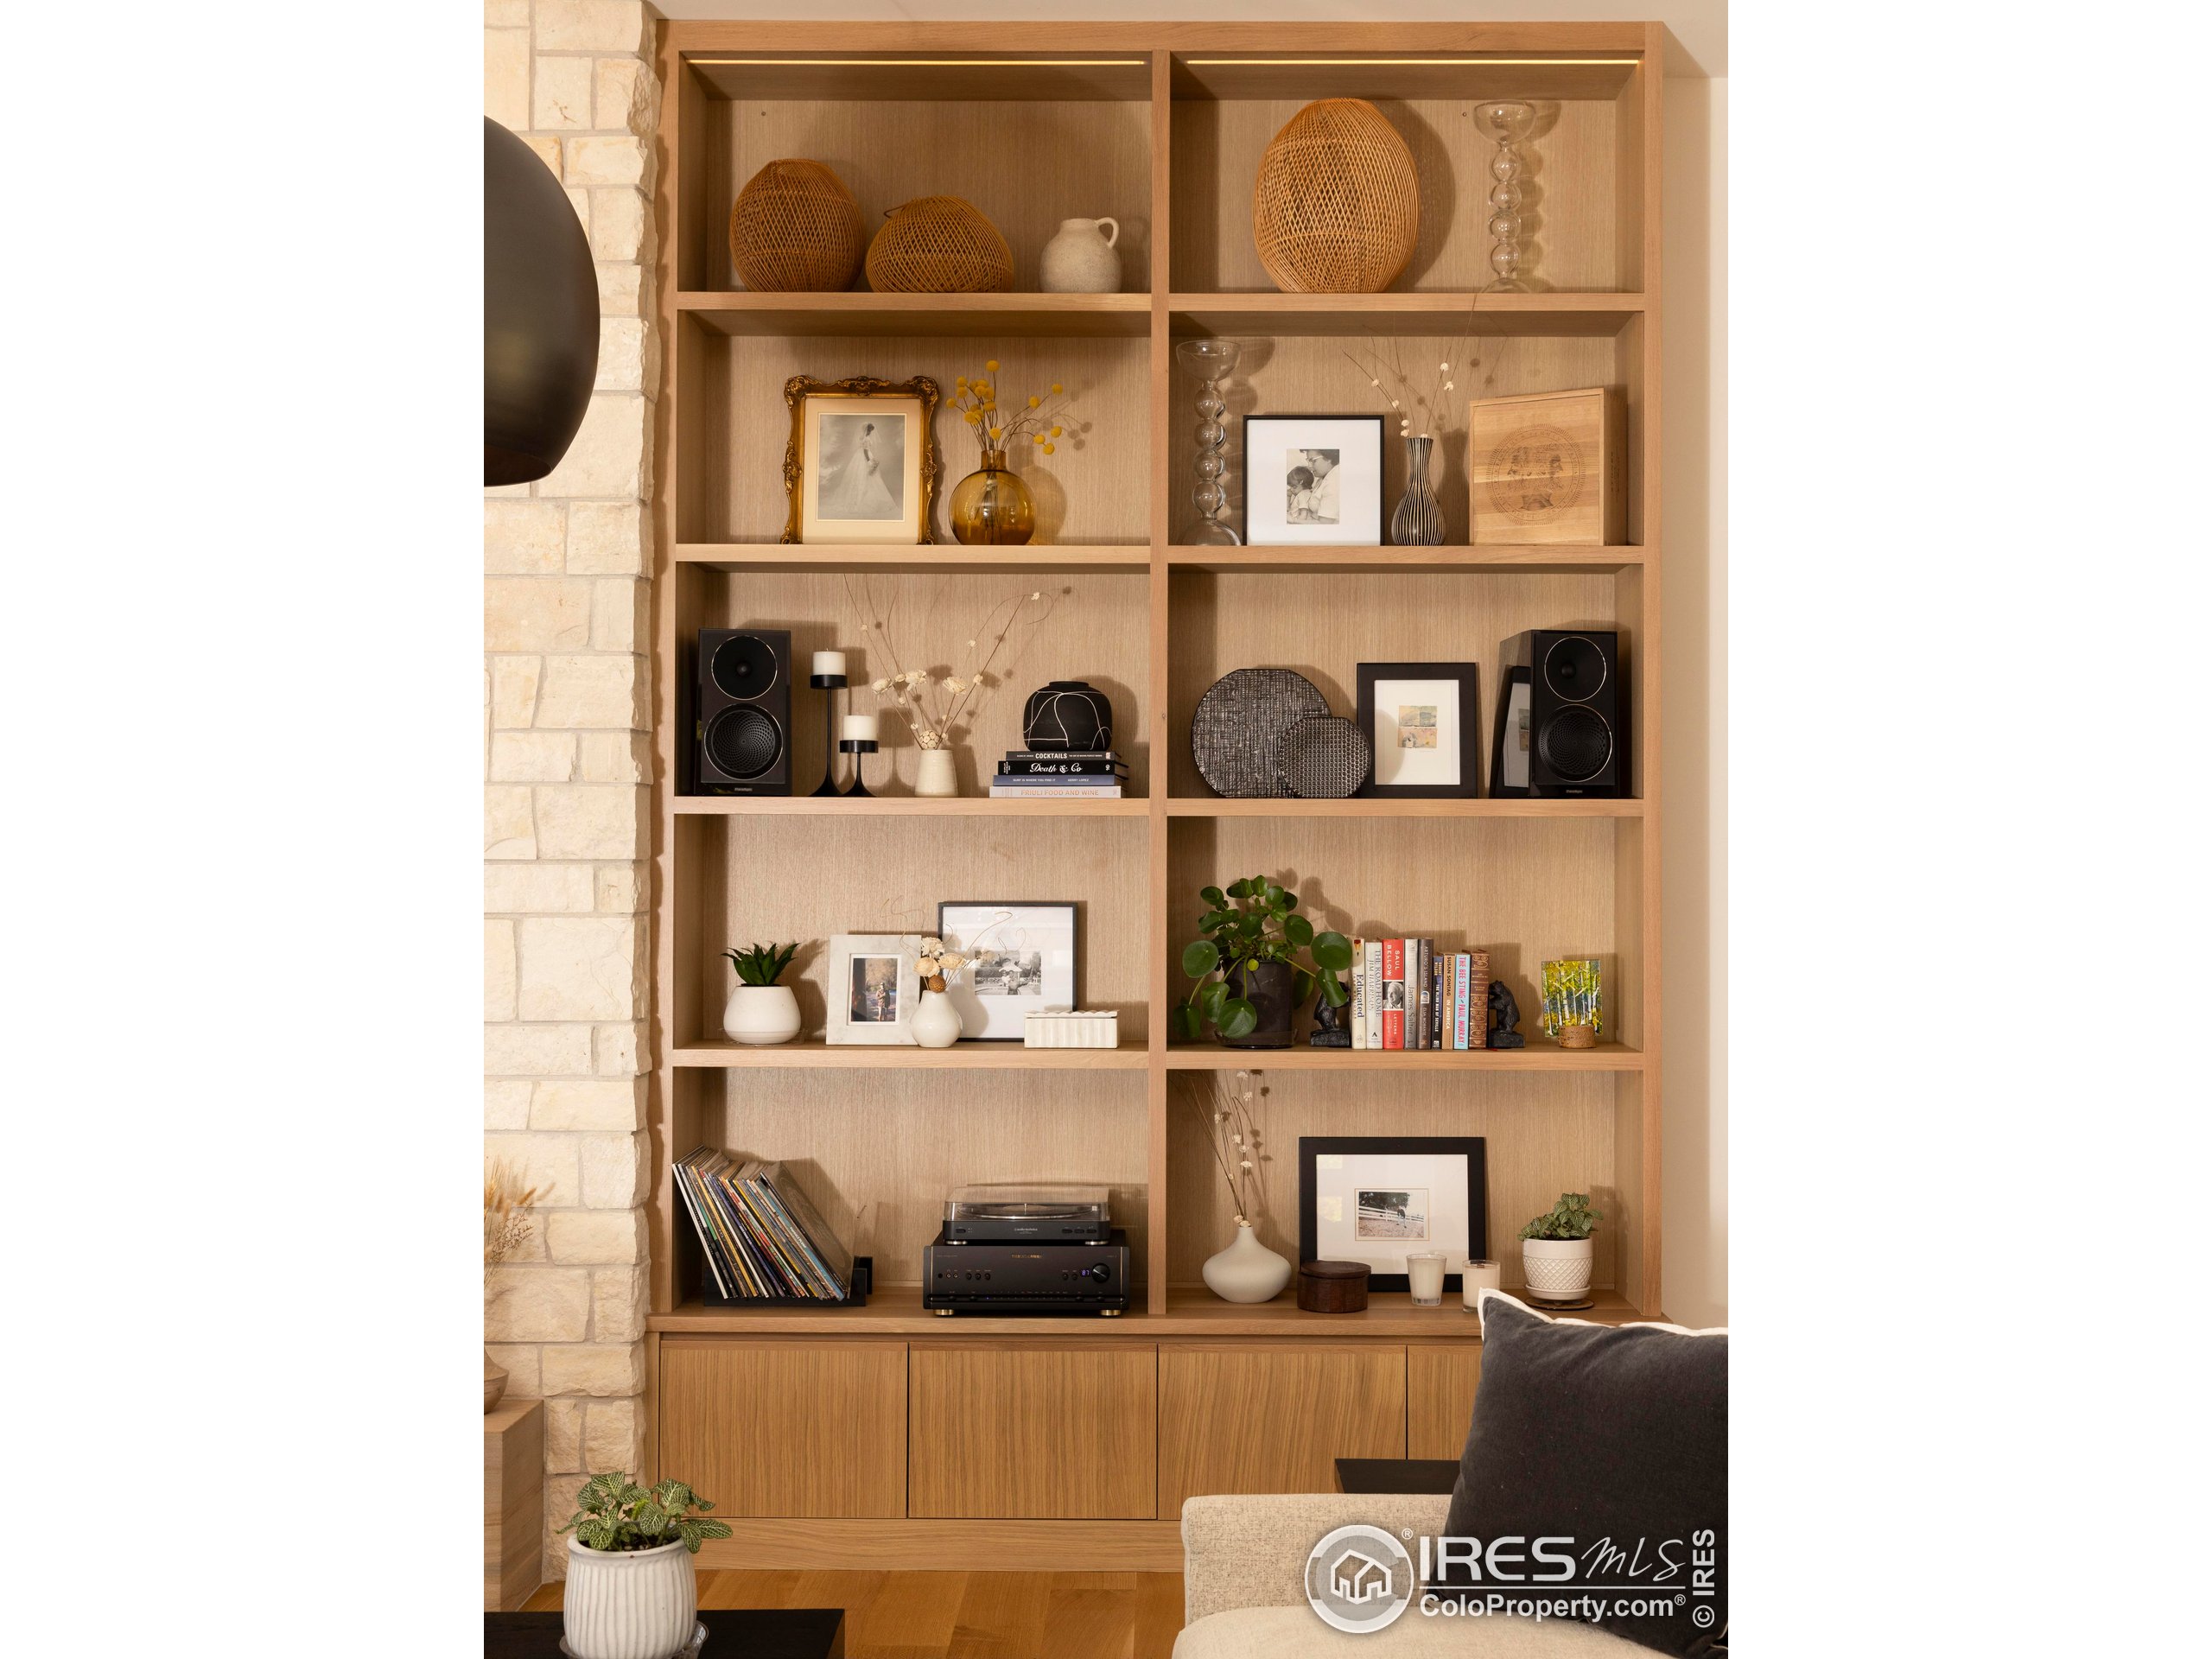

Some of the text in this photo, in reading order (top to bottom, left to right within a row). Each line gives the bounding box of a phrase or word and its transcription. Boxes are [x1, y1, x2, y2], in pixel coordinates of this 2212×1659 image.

[1029, 762, 1083, 773] Death & Co
[1356, 974, 1364, 1018] Educated
